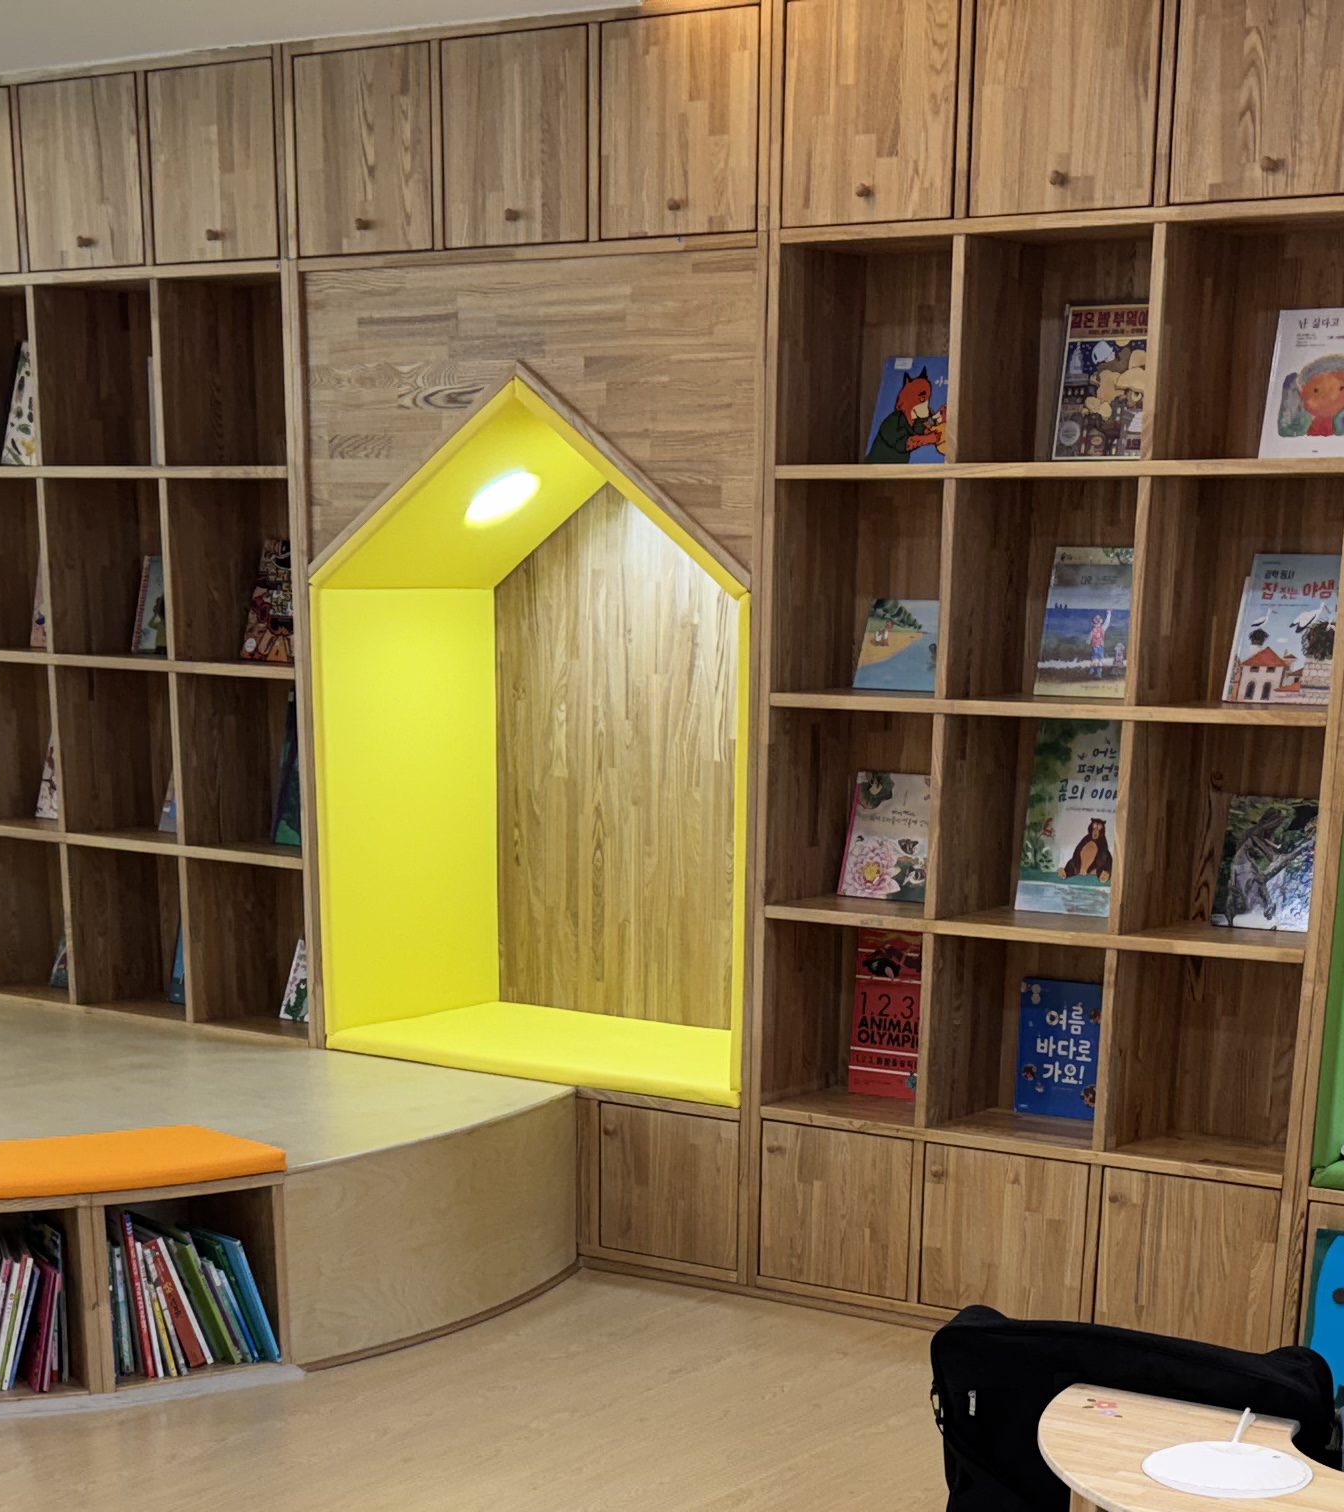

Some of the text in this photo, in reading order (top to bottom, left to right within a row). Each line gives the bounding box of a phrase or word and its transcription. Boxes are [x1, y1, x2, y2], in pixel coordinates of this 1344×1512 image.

[1097, 311, 1111, 328] 밤
[1261, 581, 1278, 601] 집
[1302, 579, 1335, 599] 야생
[1058, 778, 1085, 802] 곰의
[1045, 1003, 1086, 1035] 여름
[1036, 1035, 1092, 1062] 바다로
[1042, 1060, 1085, 1085] 가요!
